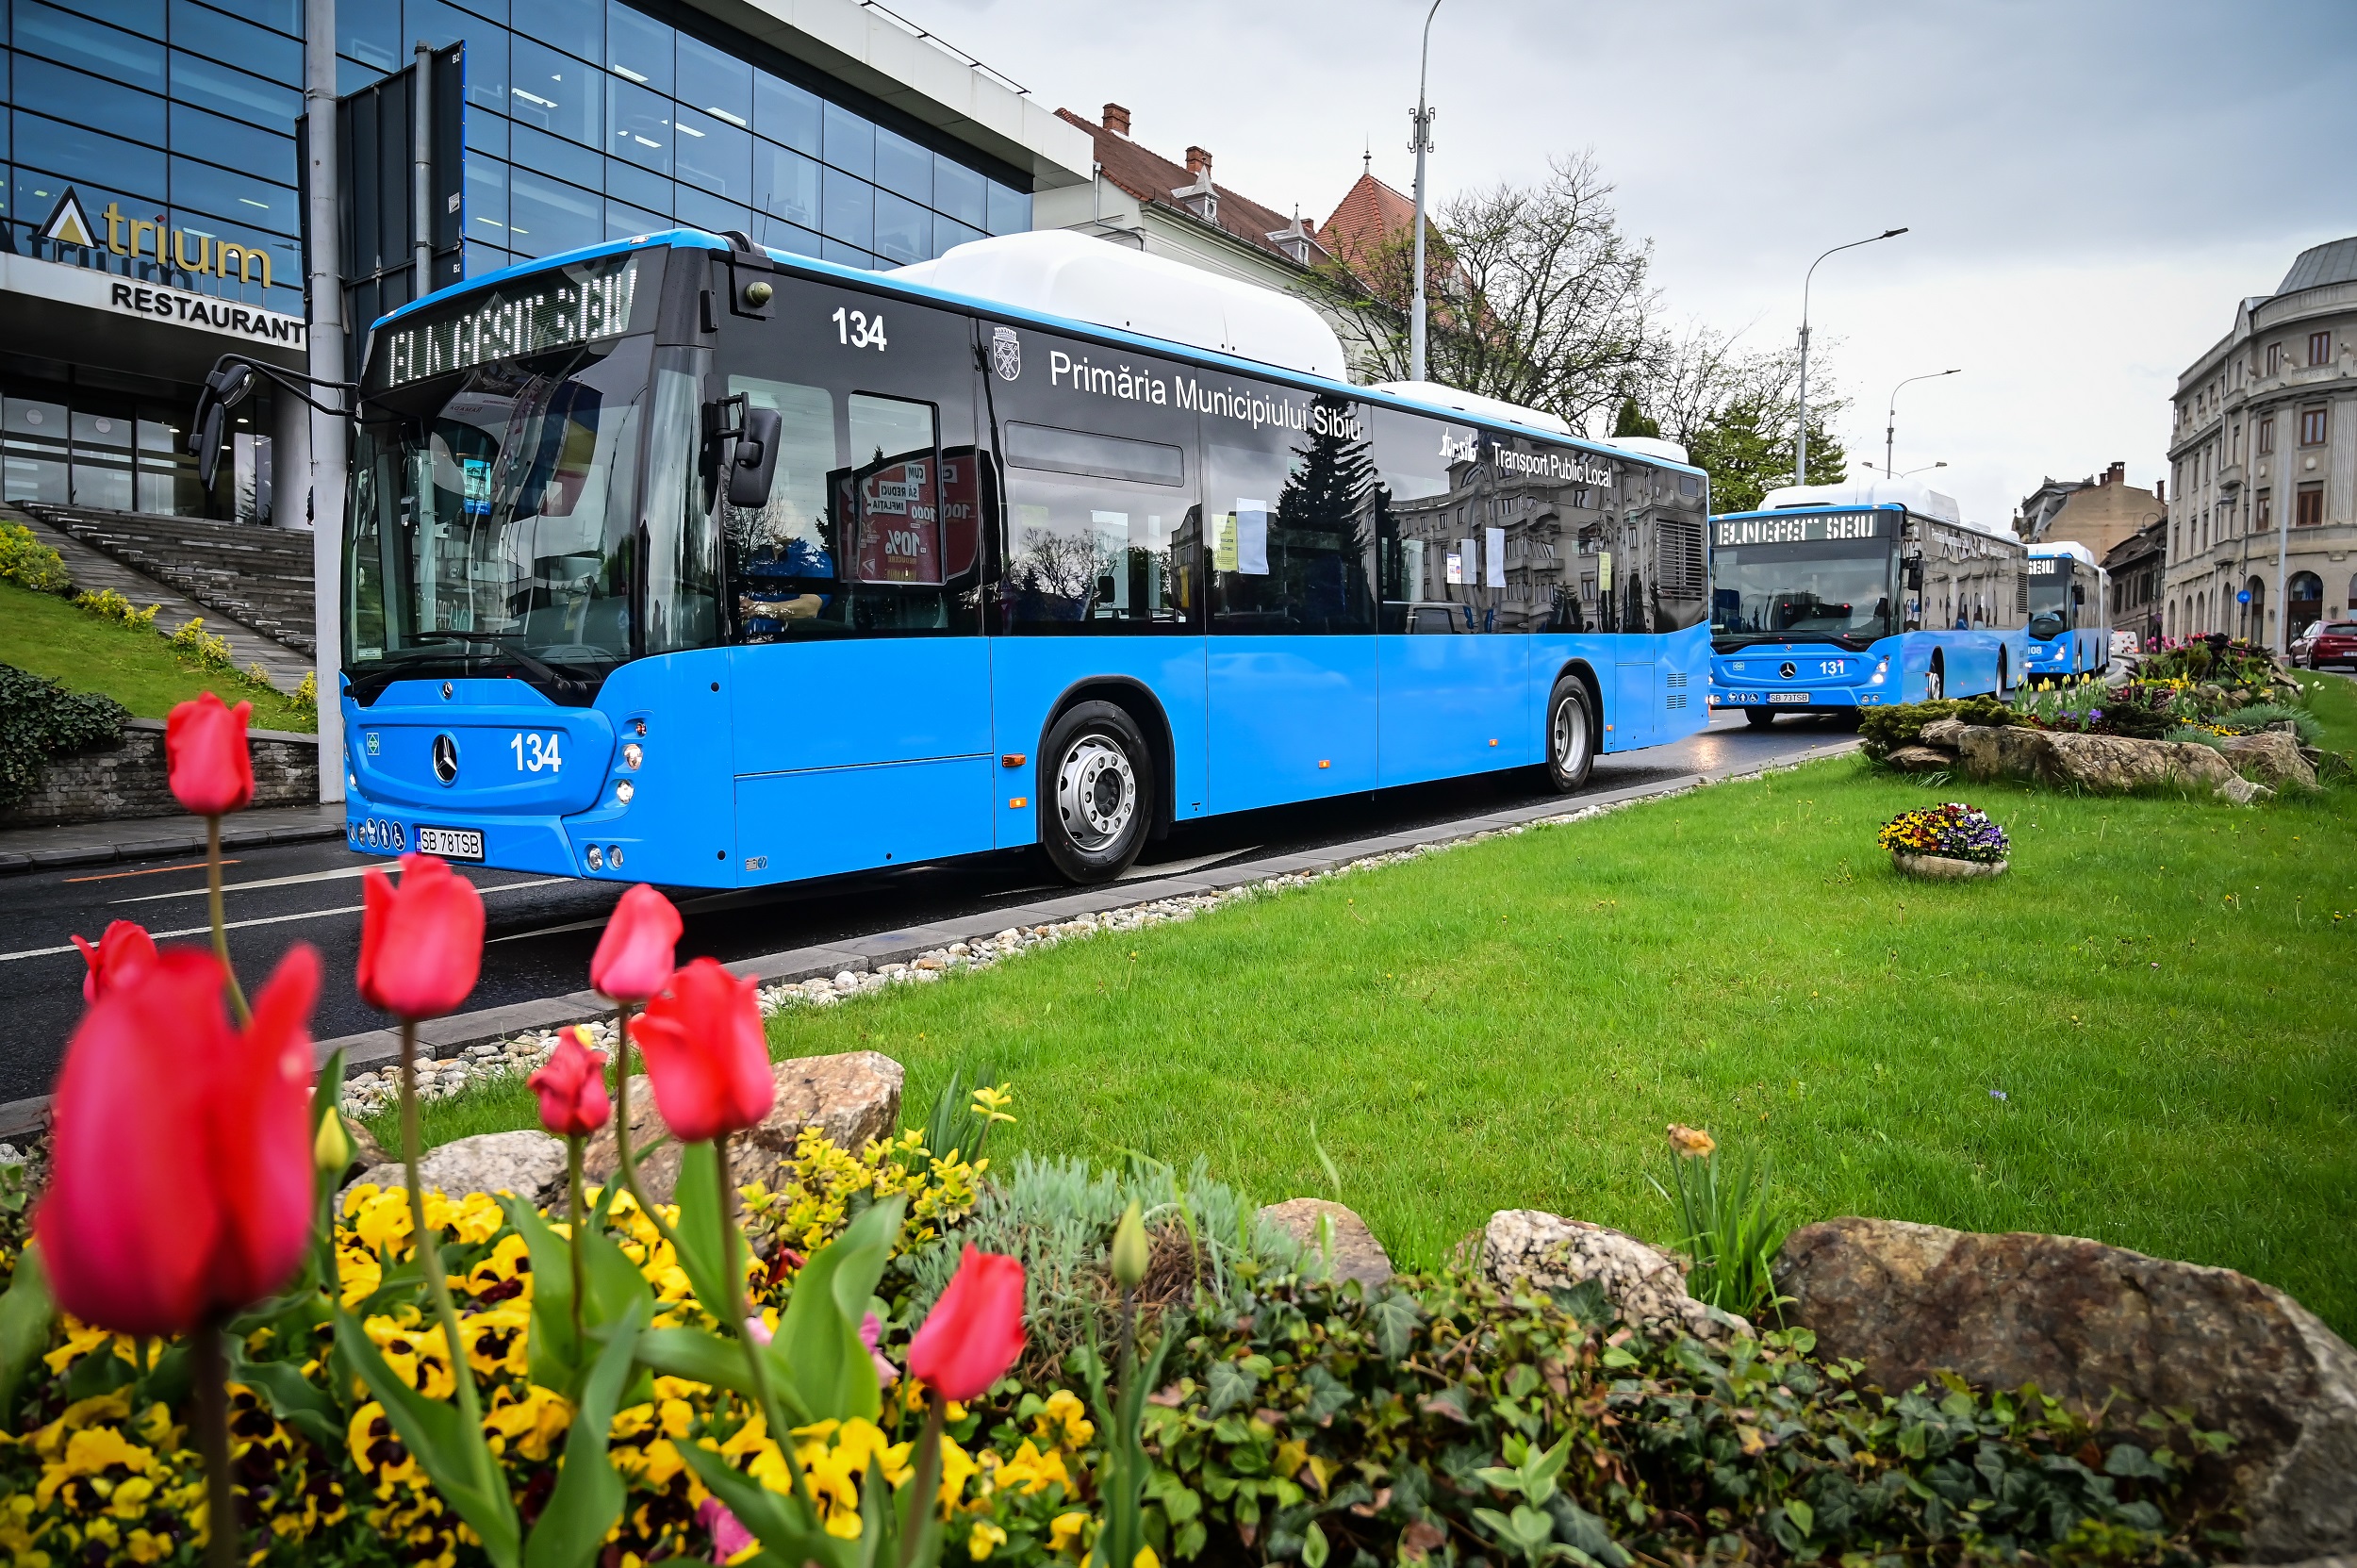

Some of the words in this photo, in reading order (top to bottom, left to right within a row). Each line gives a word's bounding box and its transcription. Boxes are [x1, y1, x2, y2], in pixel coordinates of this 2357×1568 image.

[111, 282, 305, 344] RESTAURANT
[832, 306, 887, 352] 134
[1049, 350, 1167, 405] Primăria
[1175, 376, 1308, 431] Municipiului
[1313, 404, 1361, 441] Sibiu
[1492, 441, 1549, 478] Transport
[1550, 454, 1584, 483] Public
[1585, 461, 1612, 488] Local
[1819, 661, 1845, 675] 131
[510, 733, 562, 772] 134
[421, 831, 437, 850] SB
[440, 833, 479, 854] 78TSB
